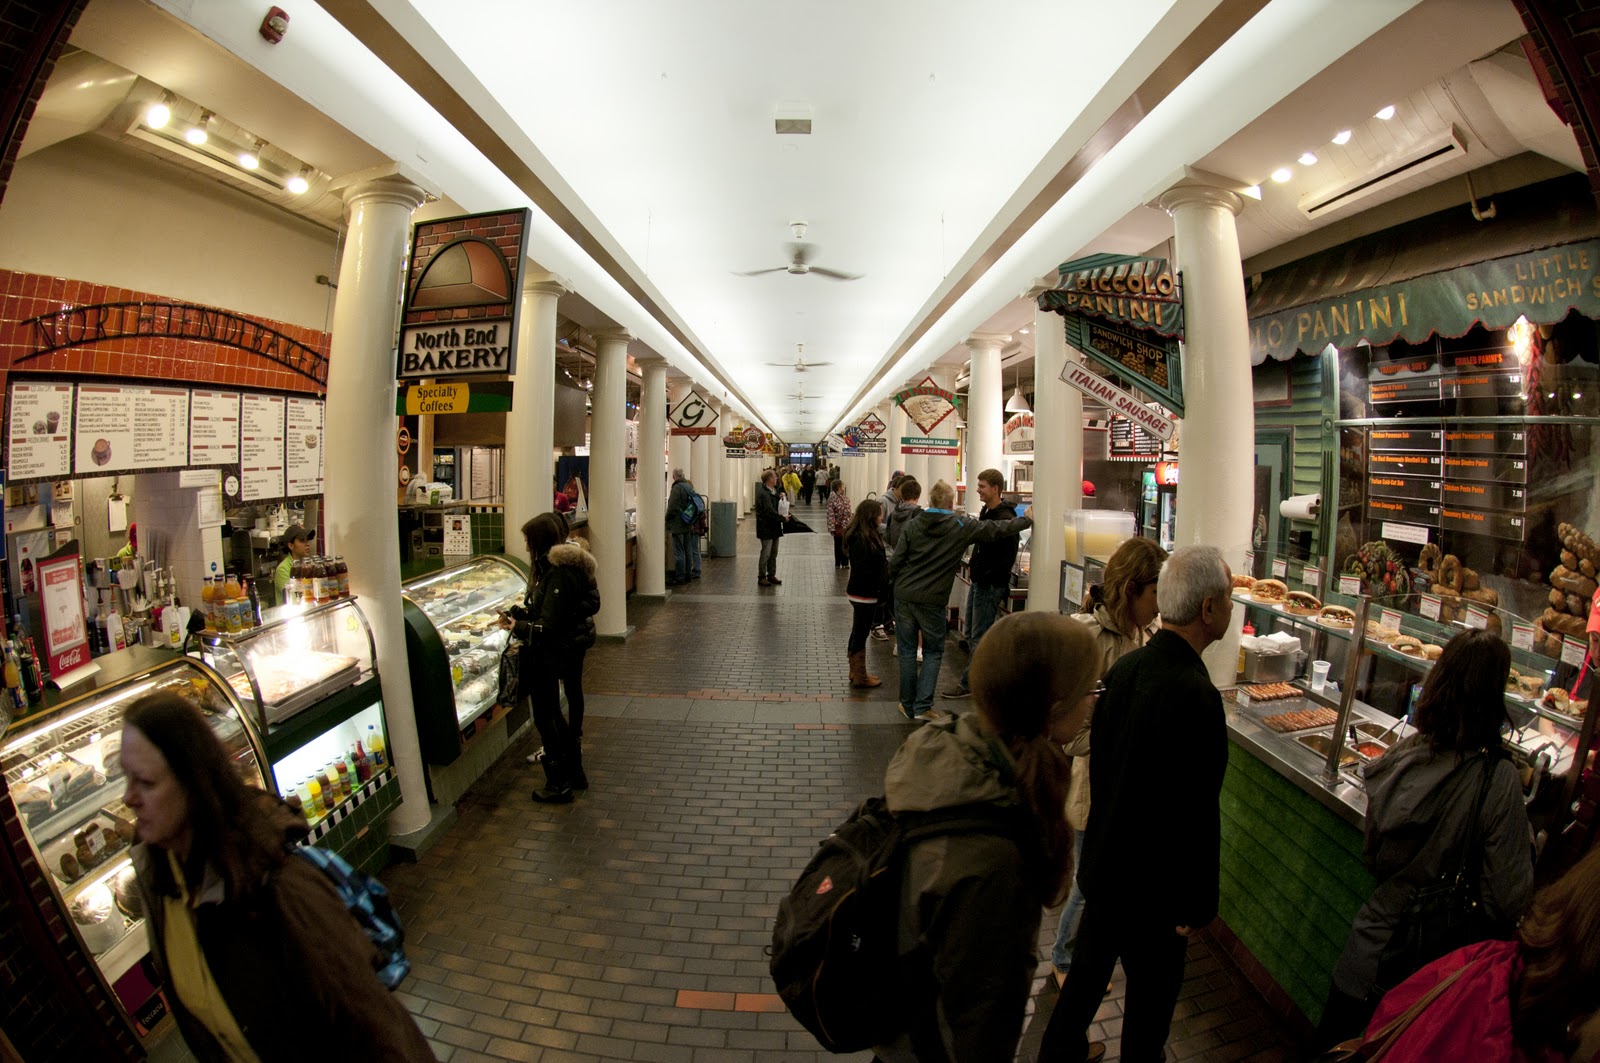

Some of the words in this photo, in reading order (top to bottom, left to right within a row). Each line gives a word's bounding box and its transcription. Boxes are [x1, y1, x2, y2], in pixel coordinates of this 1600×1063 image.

[1515, 250, 1589, 281] LITTLE
[1077, 273, 1174, 296] PICCOLO
[1466, 276, 1582, 310] SANDWICH
[1067, 294, 1162, 326] PANINI
[1297, 292, 1408, 341] PANINI
[415, 328, 460, 350] North
[464, 325, 498, 346] End
[1116, 325, 1148, 340] LITTLE
[1092, 326, 1134, 350] SANDWICH
[1136, 342, 1164, 361] SHOP
[404, 347, 508, 372] BAKERY
[1455, 355, 1477, 366] GRILLED
[417, 385, 458, 401] Specialty
[900, 390, 911, 400] LA
[913, 387, 953, 400] PASTARIA
[1069, 369, 1117, 402] ITALIAN
[1115, 397, 1168, 433] SAUSAGE
[420, 401, 454, 413] Coffees
[1512, 433, 1522, 441] 7.99
[1513, 461, 1524, 469] 7.99
[1512, 489, 1523, 497] 7.99
[1510, 518, 1522, 526] 6.99
